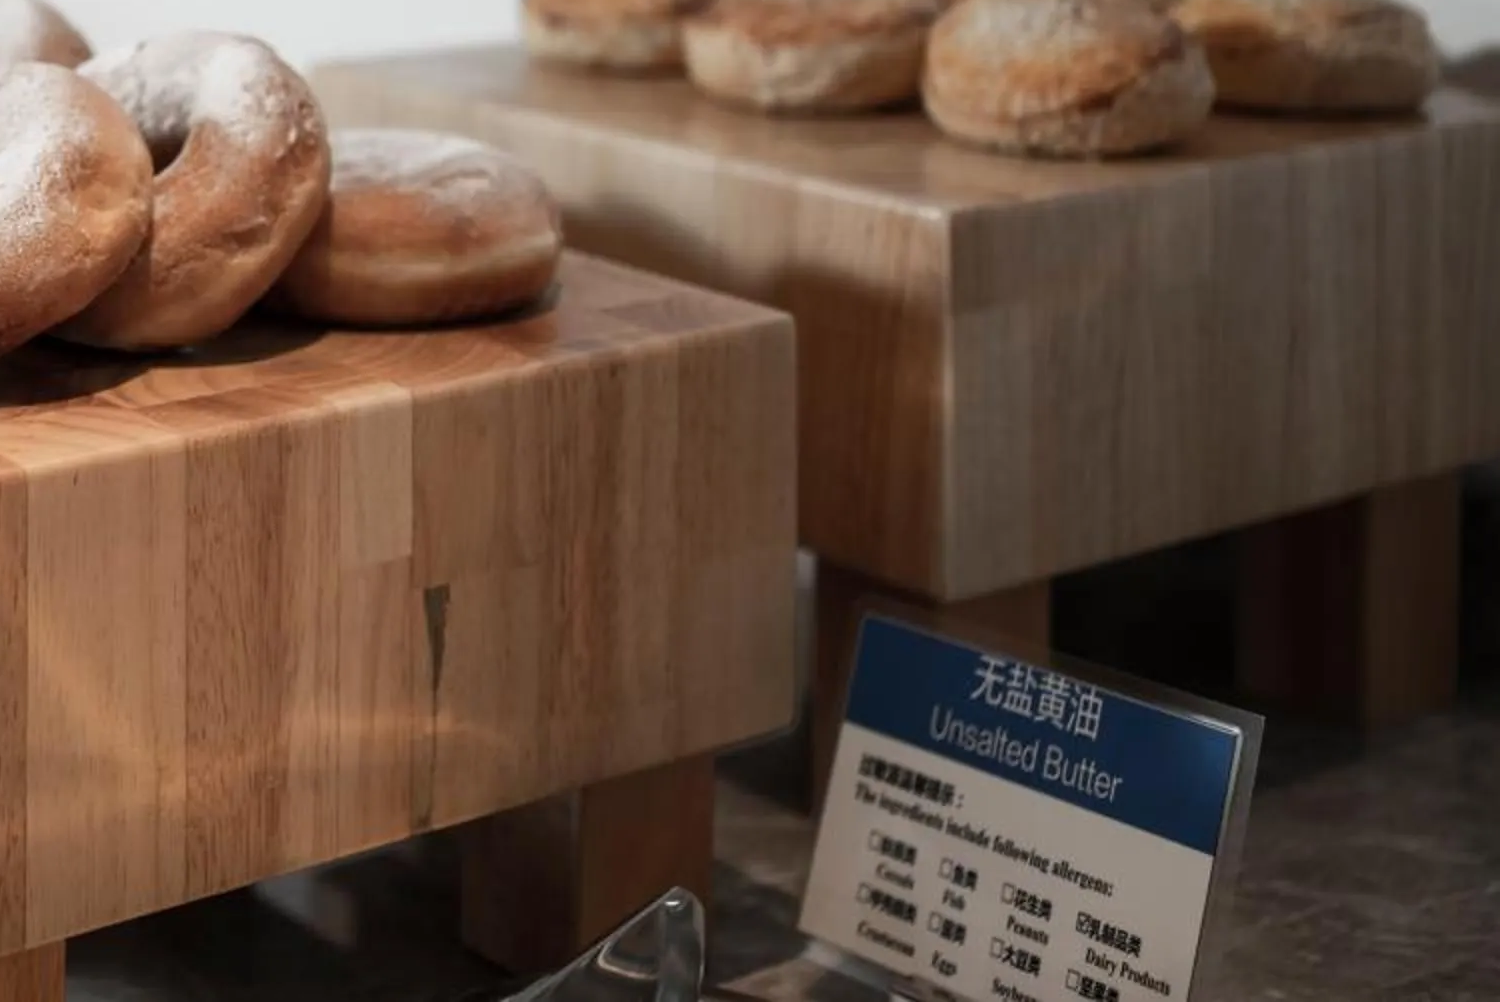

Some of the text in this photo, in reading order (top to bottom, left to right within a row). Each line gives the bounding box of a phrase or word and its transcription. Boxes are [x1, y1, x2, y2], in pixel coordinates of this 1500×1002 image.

[970, 654, 1103, 742] 无盐黄油
[929, 704, 1124, 803] Unsalted Butter
[854, 781, 1114, 897] The ingredients include following allergens:
[942, 888, 966, 912] Fish
[1014, 887, 1052, 922] 花生类
[1006, 915, 1049, 946] Peanuts
[1002, 944, 1041, 978] 大豆类
[1085, 947, 1171, 996] Dairy Products
